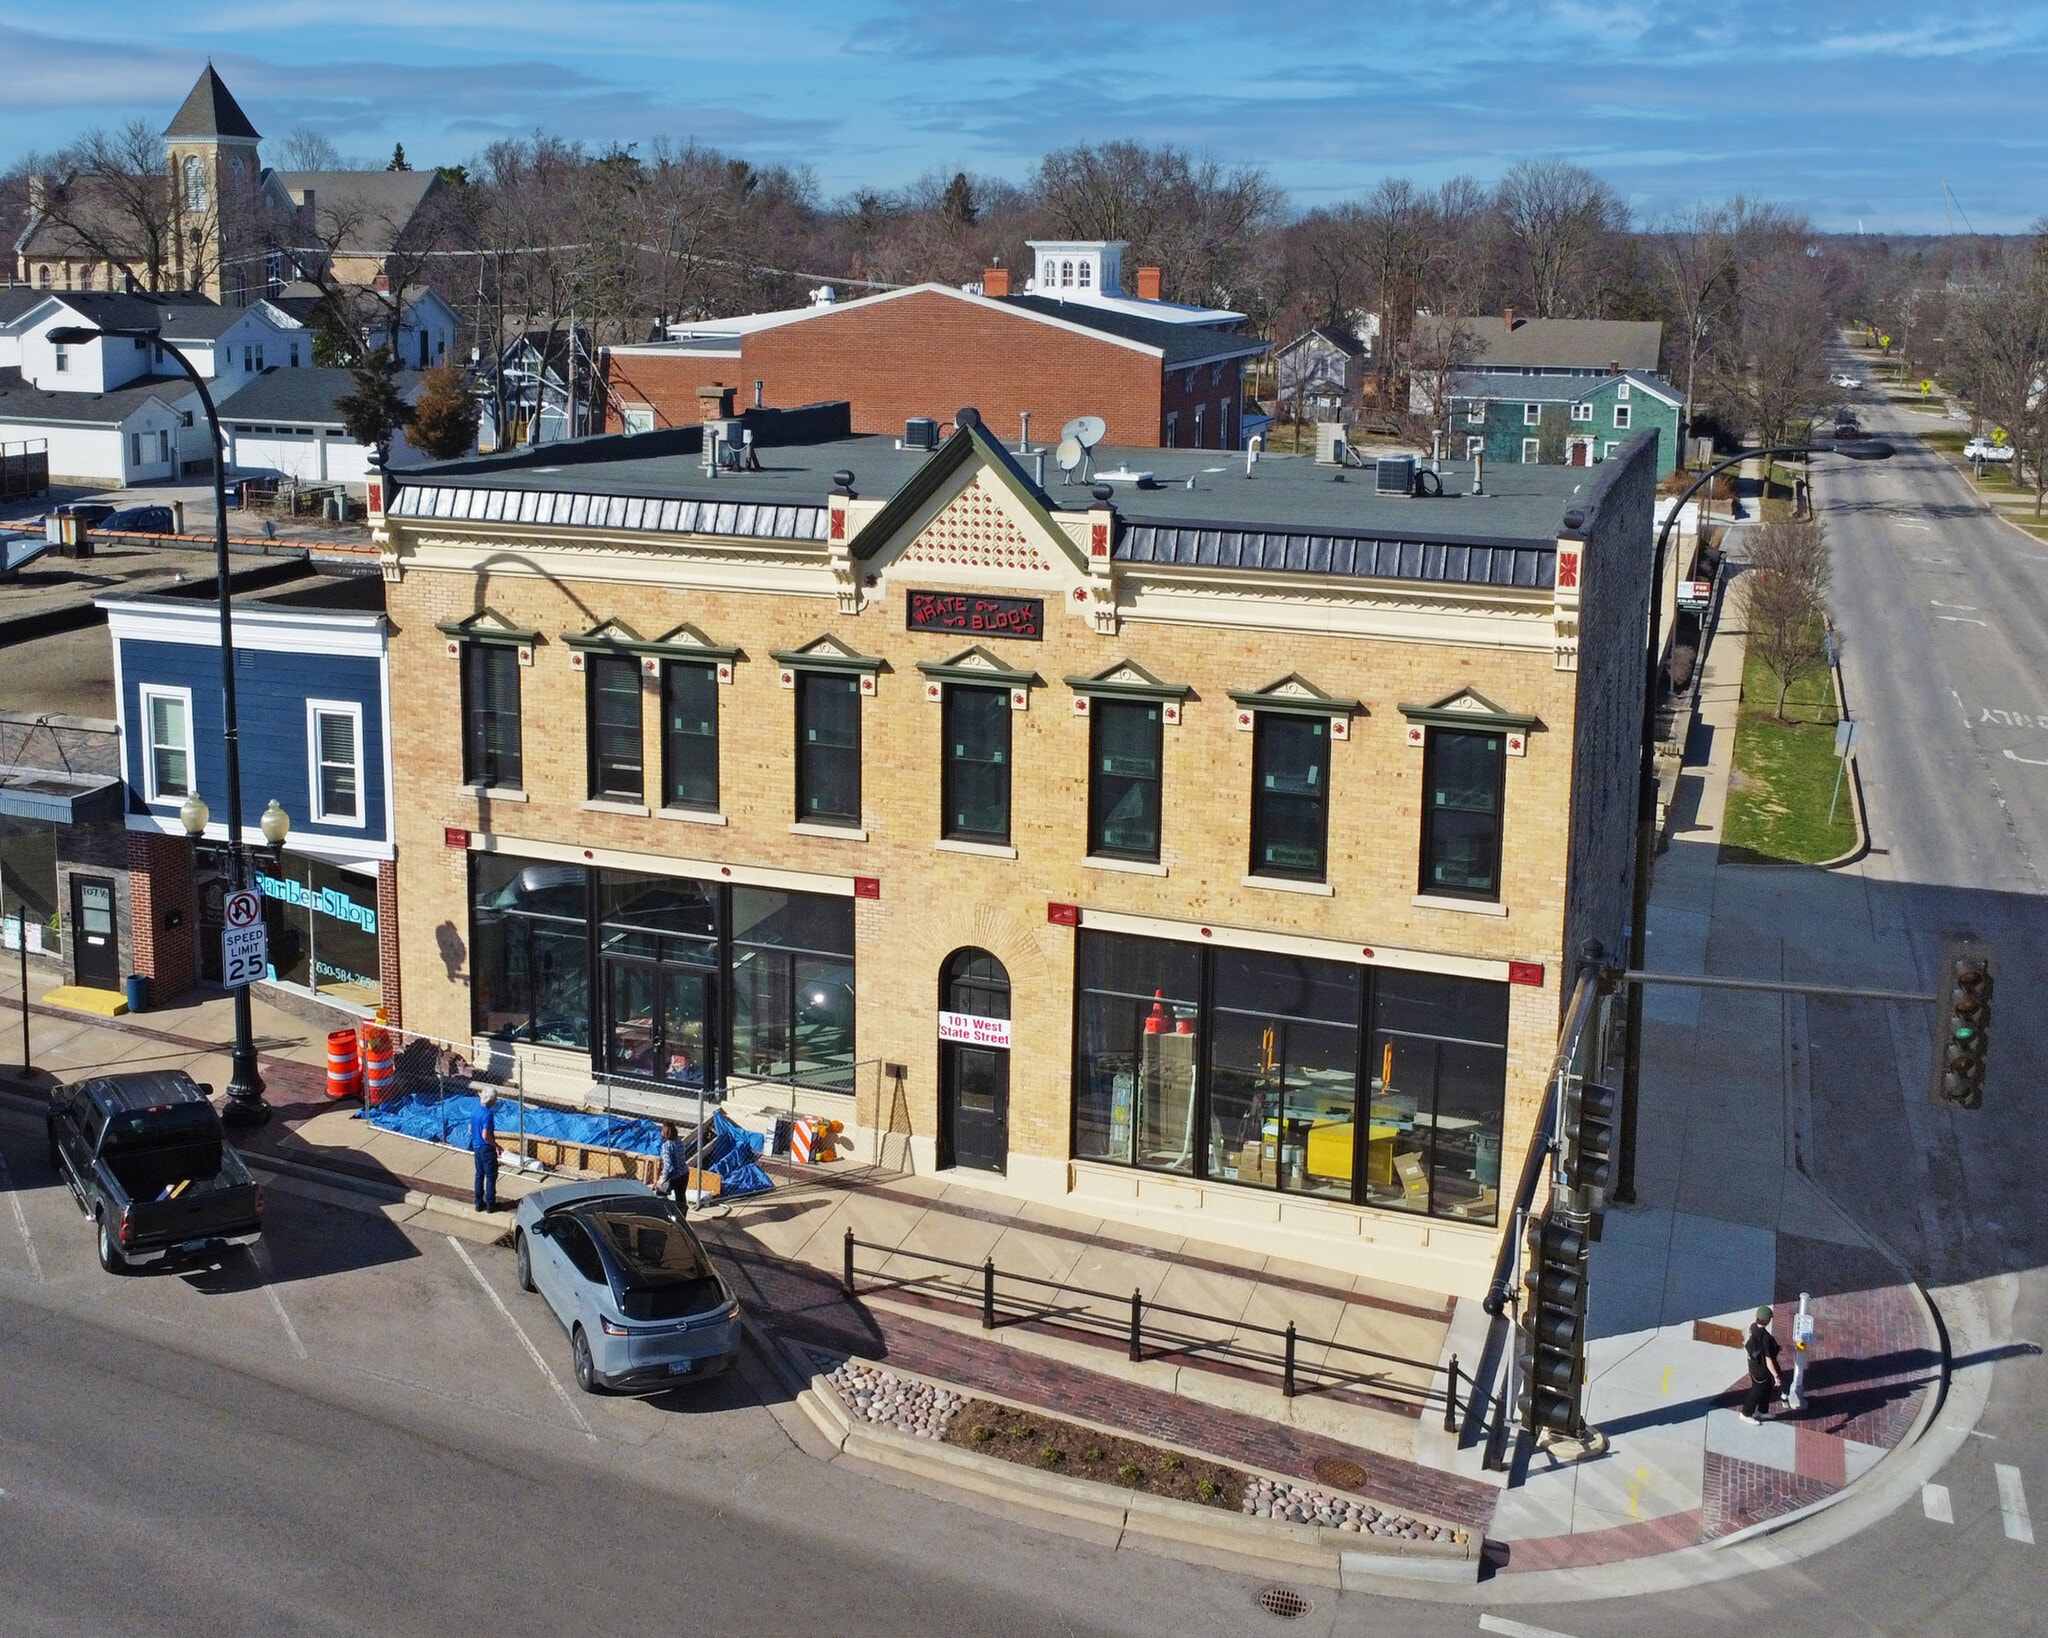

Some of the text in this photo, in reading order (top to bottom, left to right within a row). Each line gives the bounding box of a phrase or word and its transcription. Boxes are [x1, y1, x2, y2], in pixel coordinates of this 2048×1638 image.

[914, 597, 1034, 630] WRATE BLOCK
[226, 930, 263, 946] SPEED
[231, 942, 260, 957] LIMIT
[229, 954, 263, 981] 25
[948, 1016, 1002, 1032] 101 West
[940, 1025, 1009, 1045] State Street
